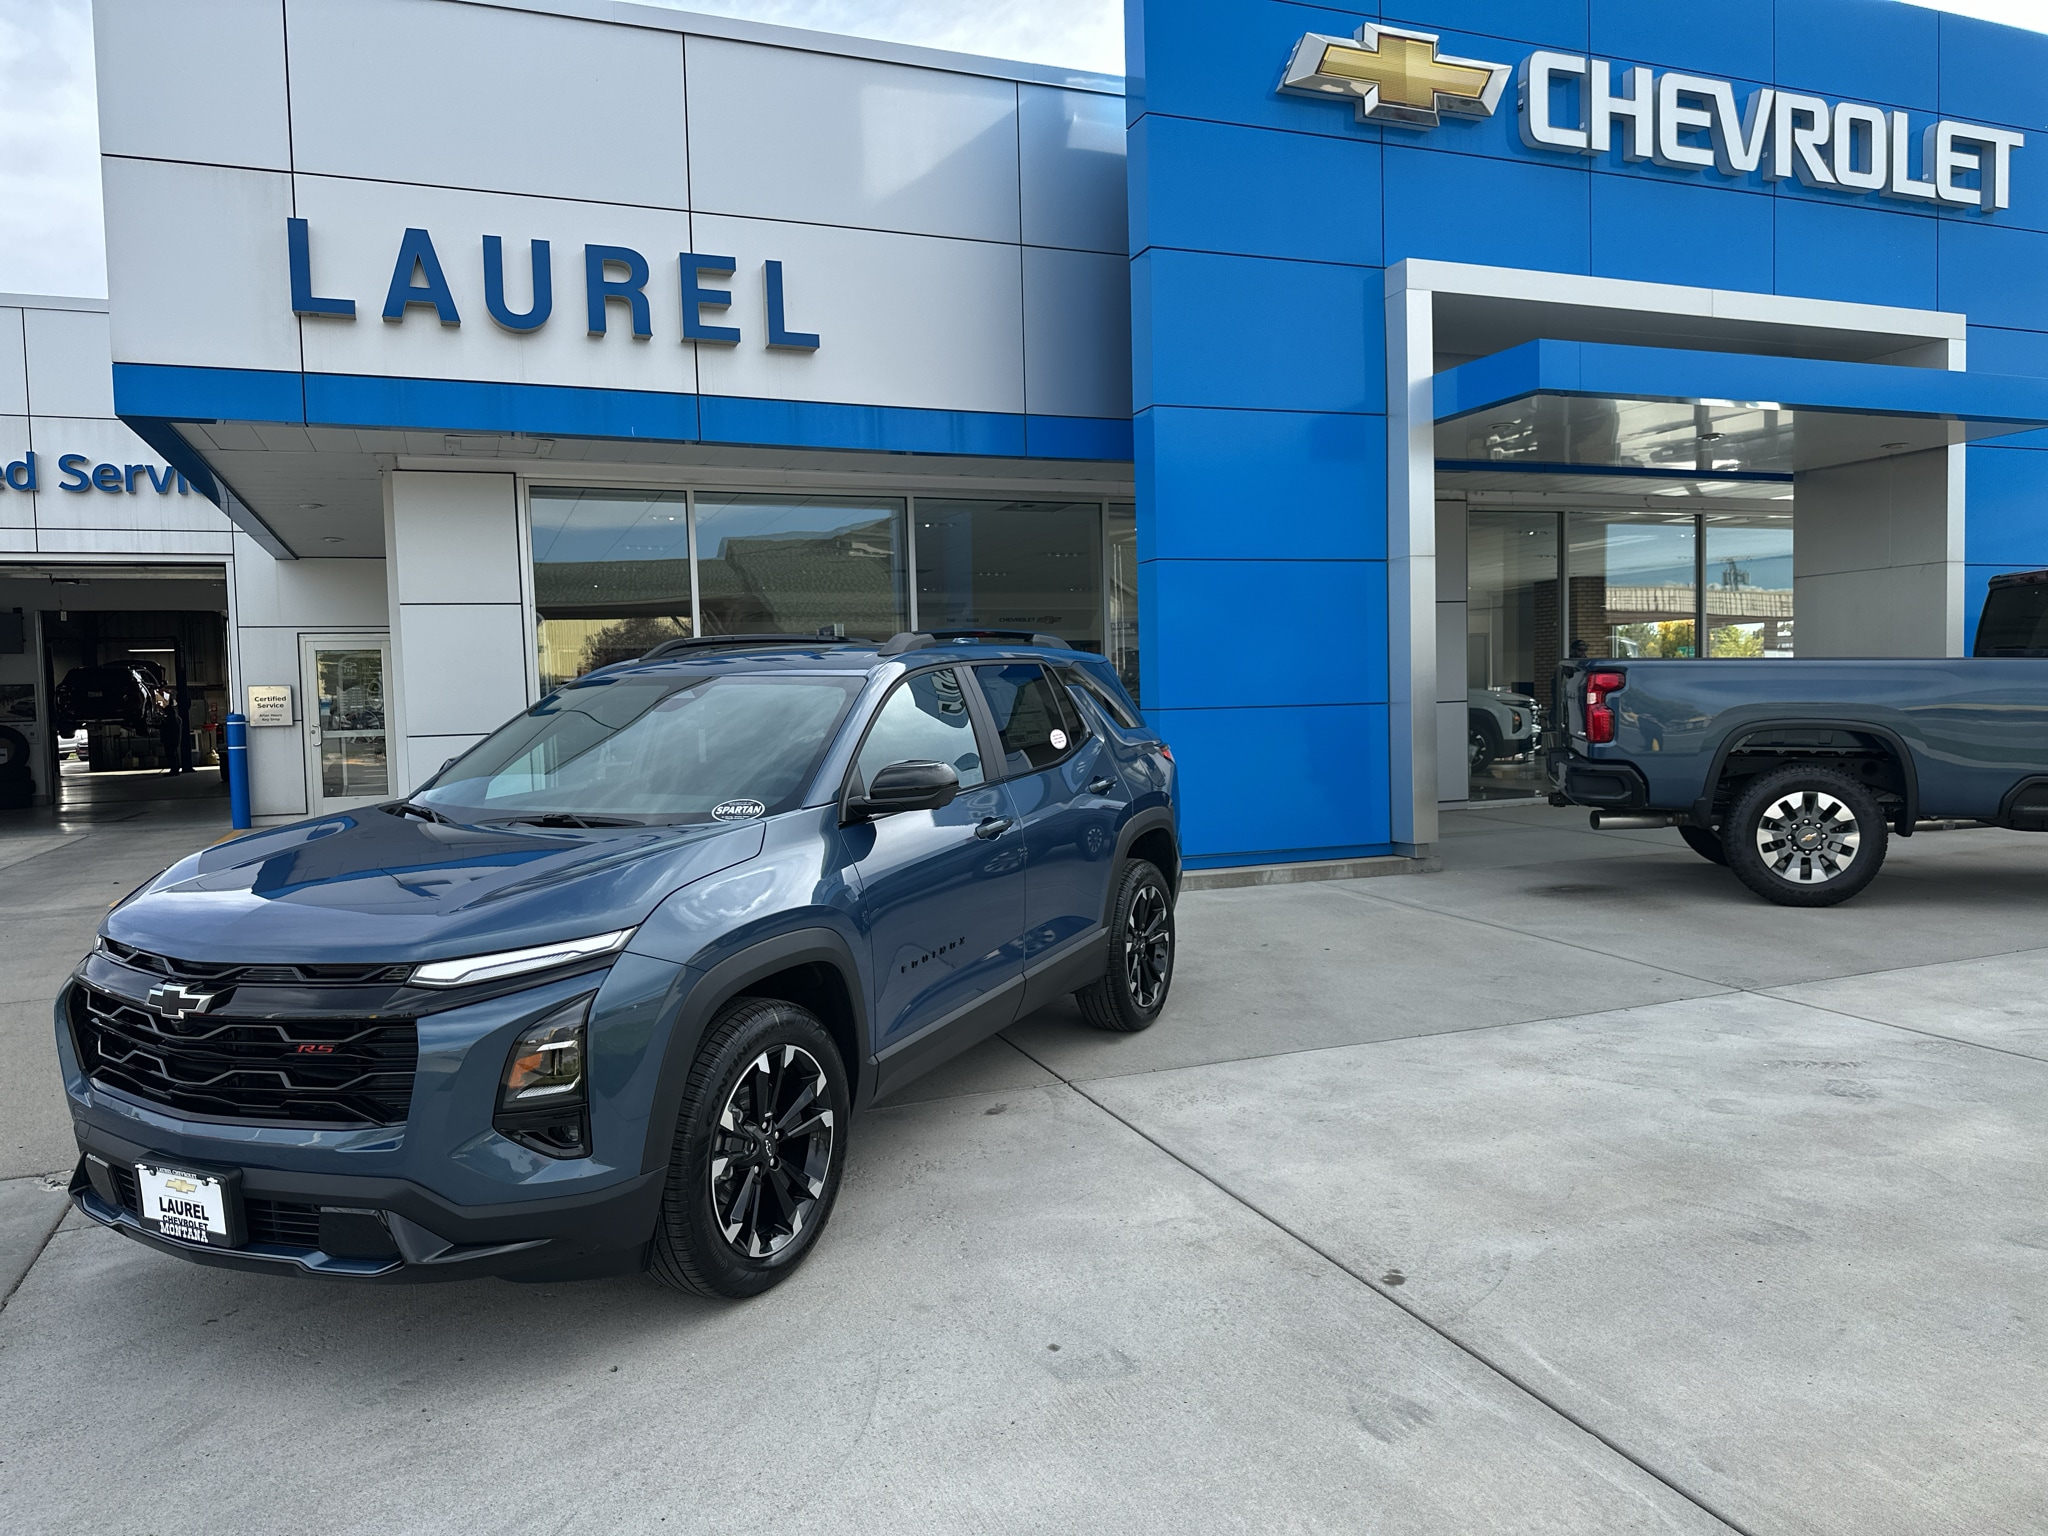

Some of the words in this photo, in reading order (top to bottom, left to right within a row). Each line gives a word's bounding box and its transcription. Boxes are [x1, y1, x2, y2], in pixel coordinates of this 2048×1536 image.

[1519, 51, 2024, 212] CHEVROLET
[287, 218, 820, 351] LAUREL
[715, 805, 762, 815] SPARTAN
[297, 1044, 335, 1054] RS
[159, 1197, 209, 1221] LAUREL
[160, 1221, 209, 1243] MONTANA
[162, 1215, 209, 1231] CHEVROLET
